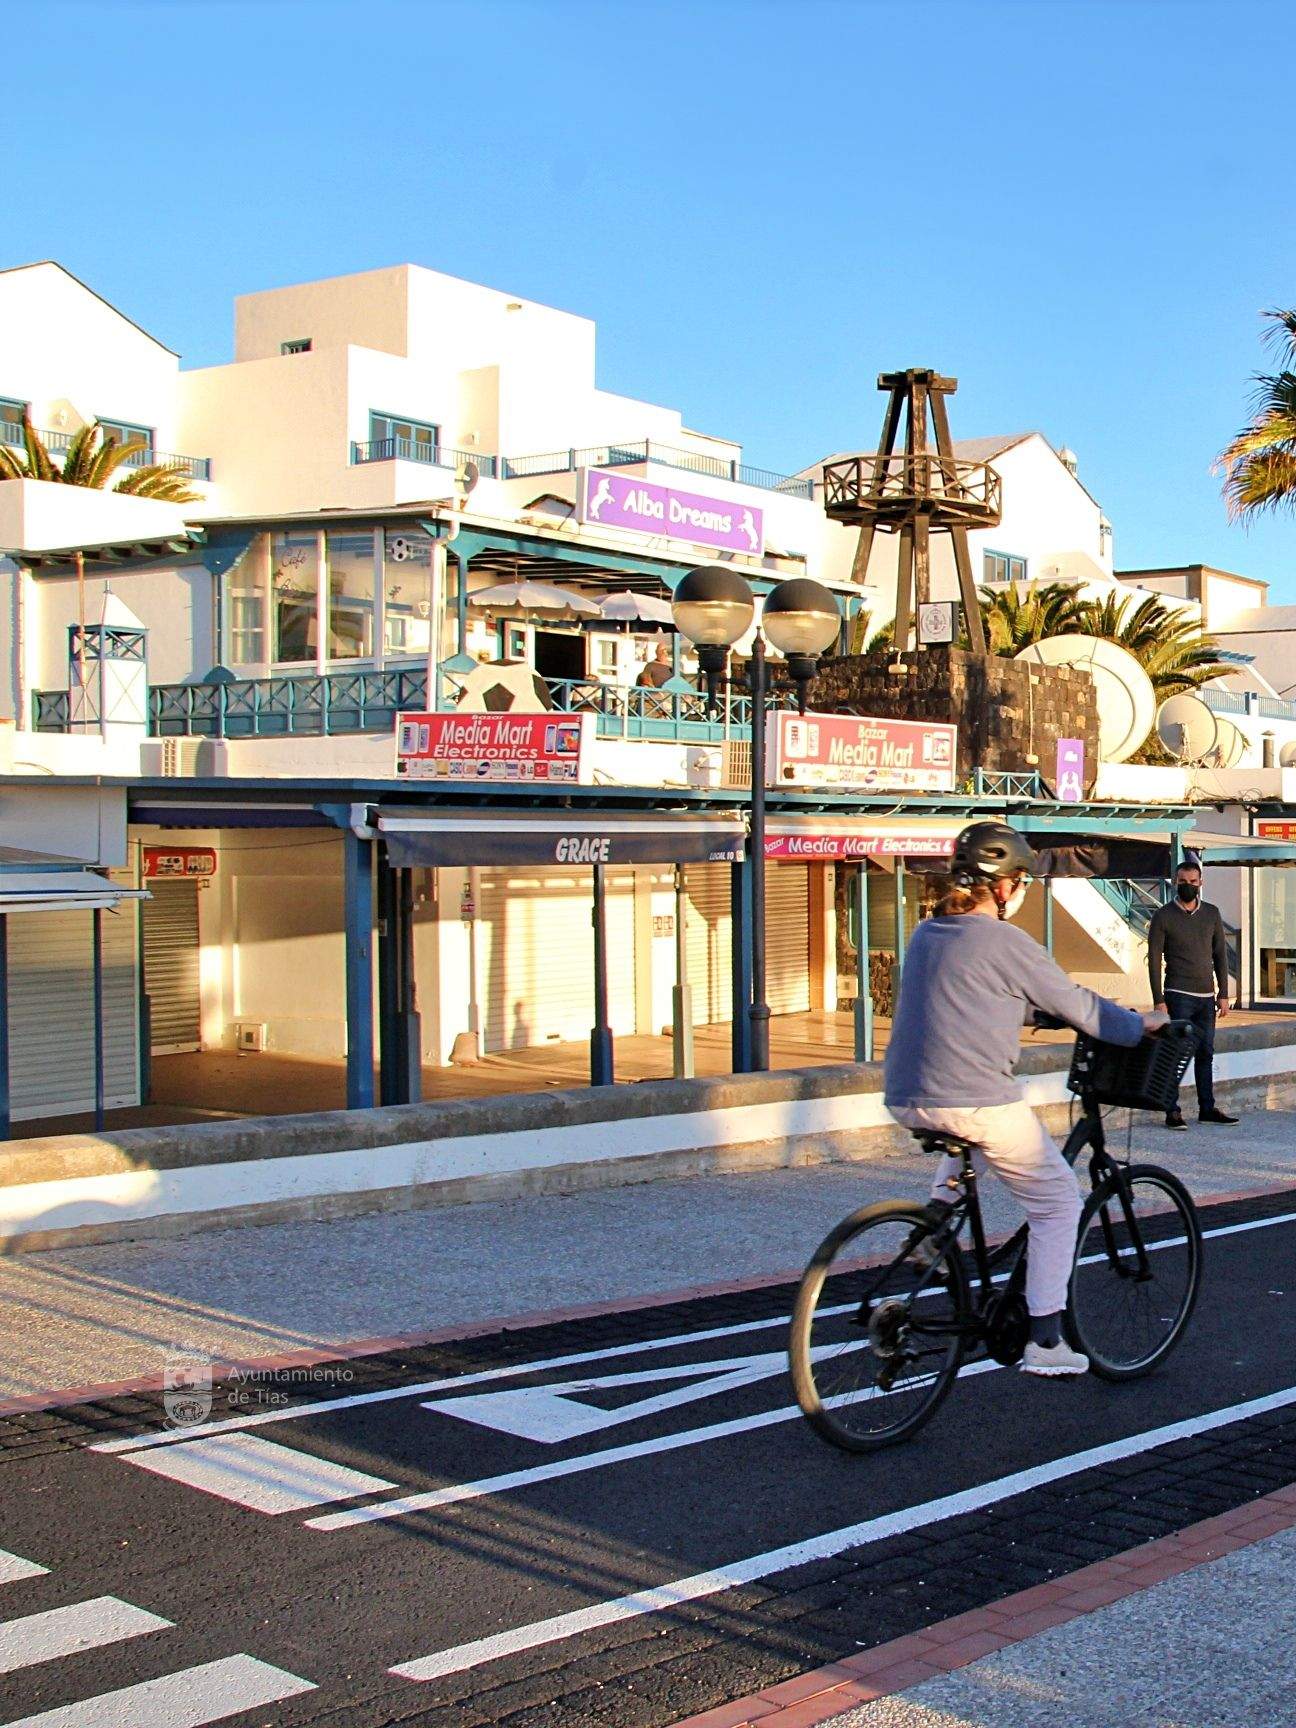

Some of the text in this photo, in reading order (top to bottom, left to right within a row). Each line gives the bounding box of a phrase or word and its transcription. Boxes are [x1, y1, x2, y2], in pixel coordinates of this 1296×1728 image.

[623, 489, 733, 533] Alba Dreams
[439, 720, 533, 745] Media Mart
[858, 724, 888, 739] Bazar
[433, 745, 538, 758] Electronics
[828, 737, 914, 767] Media Mart
[555, 837, 610, 863] GRACE
[788, 837, 839, 853] Media
[842, 838, 879, 853] Mart
[881, 838, 941, 853] Electronics
[708, 851, 726, 860] LOCAL
